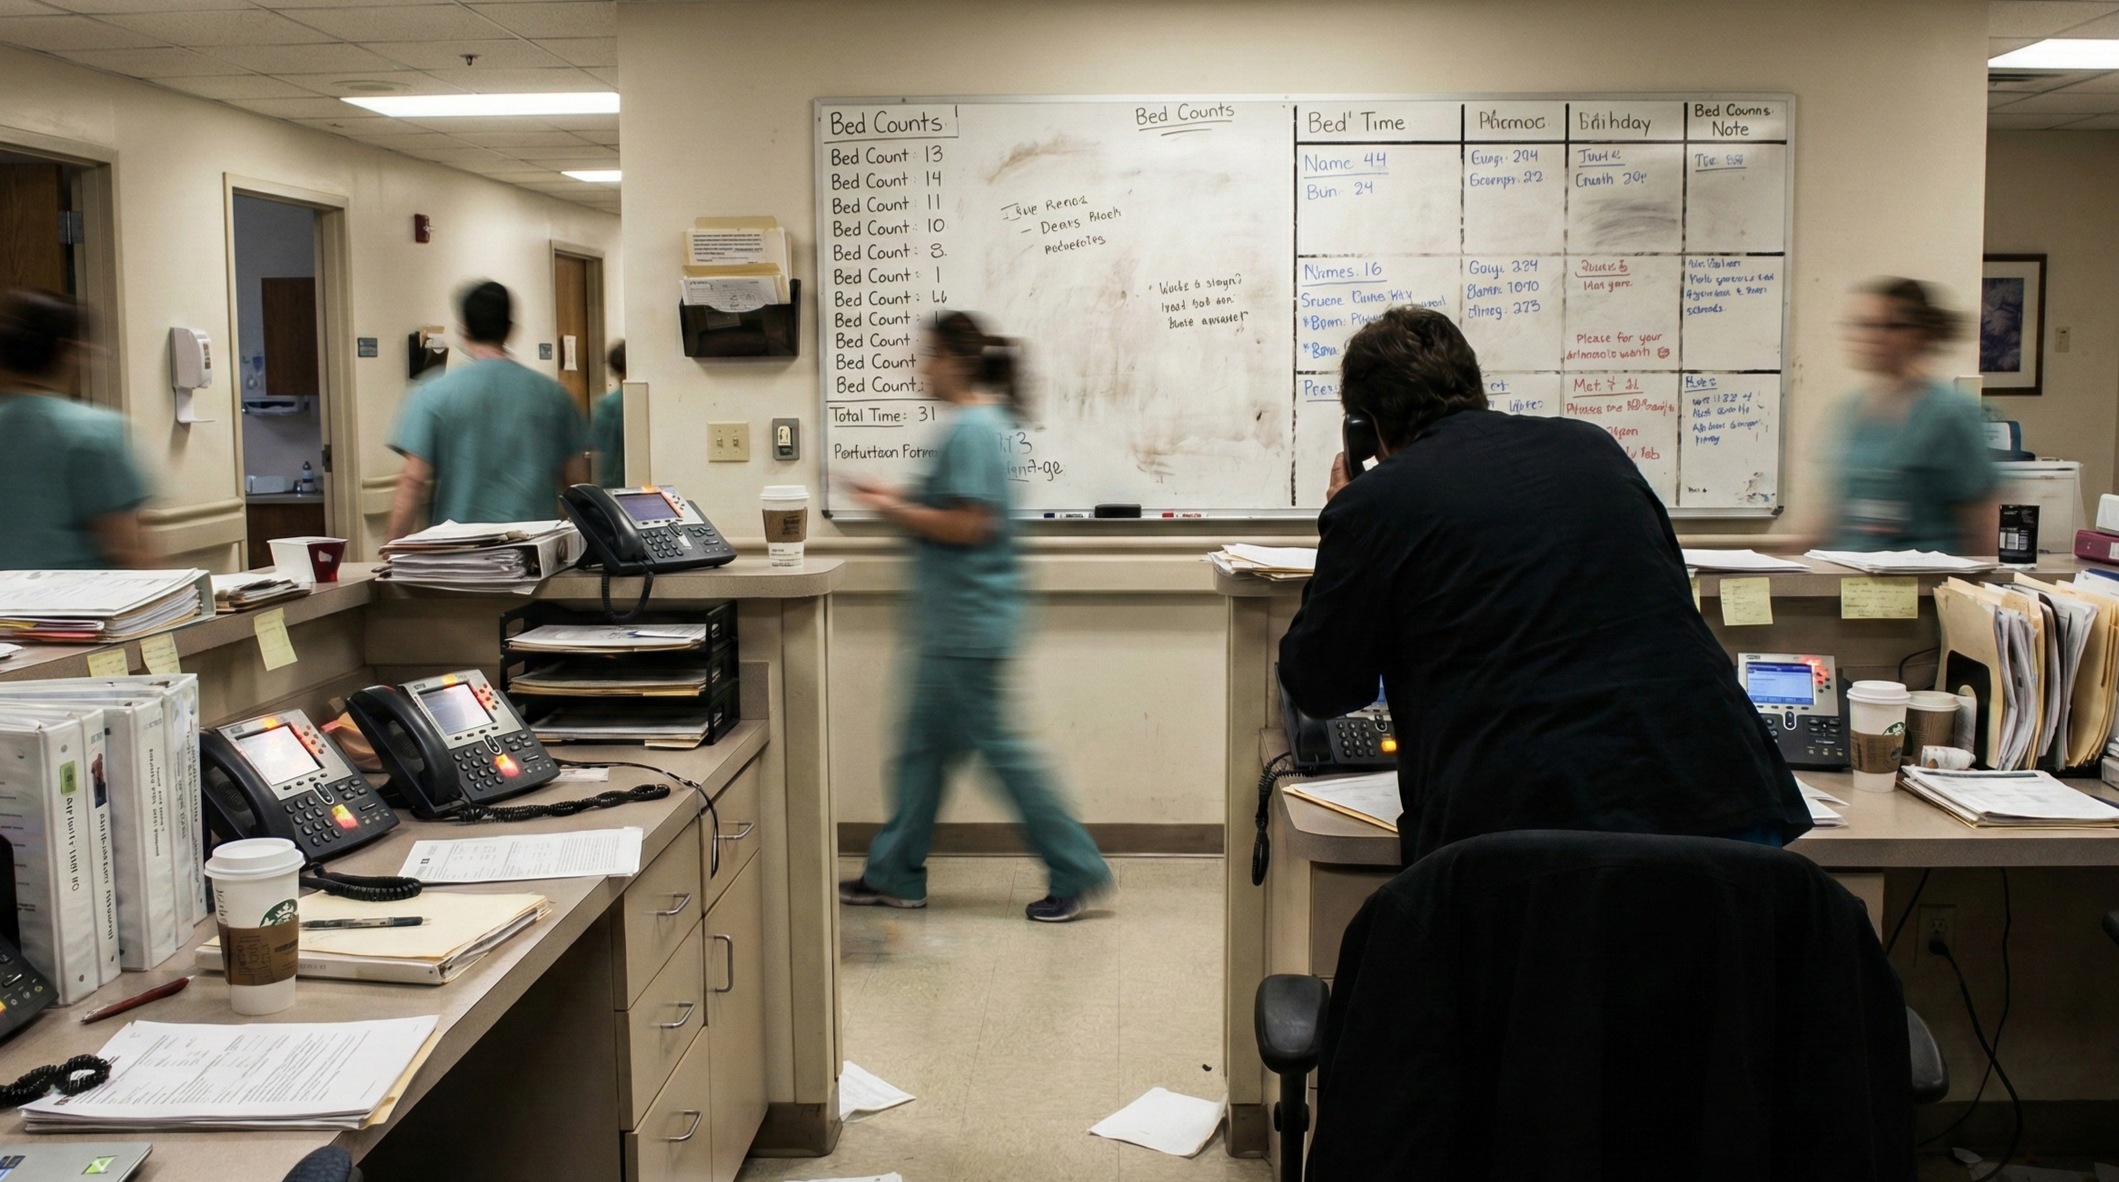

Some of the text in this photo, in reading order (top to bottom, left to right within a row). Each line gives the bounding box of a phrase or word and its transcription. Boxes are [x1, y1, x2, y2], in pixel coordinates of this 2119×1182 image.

[1136, 102, 1235, 125] Bed Counts
[1695, 104, 1720, 117] Bed
[831, 110, 943, 135] Bed Counts
[1361, 111, 1406, 131] Time
[1713, 121, 1749, 136] Note
[831, 148, 859, 166] Bed
[926, 145, 943, 162] 13
[1364, 152, 1386, 167] 44
[831, 172, 859, 190] Bed
[926, 170, 941, 186] 14
[1354, 181, 1373, 195] 24
[832, 197, 860, 214] Bed
[928, 194, 940, 209] 11
[833, 220, 861, 237] Bed
[928, 218, 945, 233] 10
[833, 244, 861, 261] Bed
[834, 268, 861, 285] Bed
[1365, 261, 1382, 276] 16
[835, 291, 862, 307] Bed
[835, 311, 862, 328] Bed
[836, 331, 863, 349] Bed
[1617, 331, 1633, 343] for
[1639, 334, 1662, 346] your
[836, 353, 916, 370] Bed Count
[837, 376, 865, 394] Bed
[829, 406, 863, 422] Total
[918, 406, 935, 421] 31
